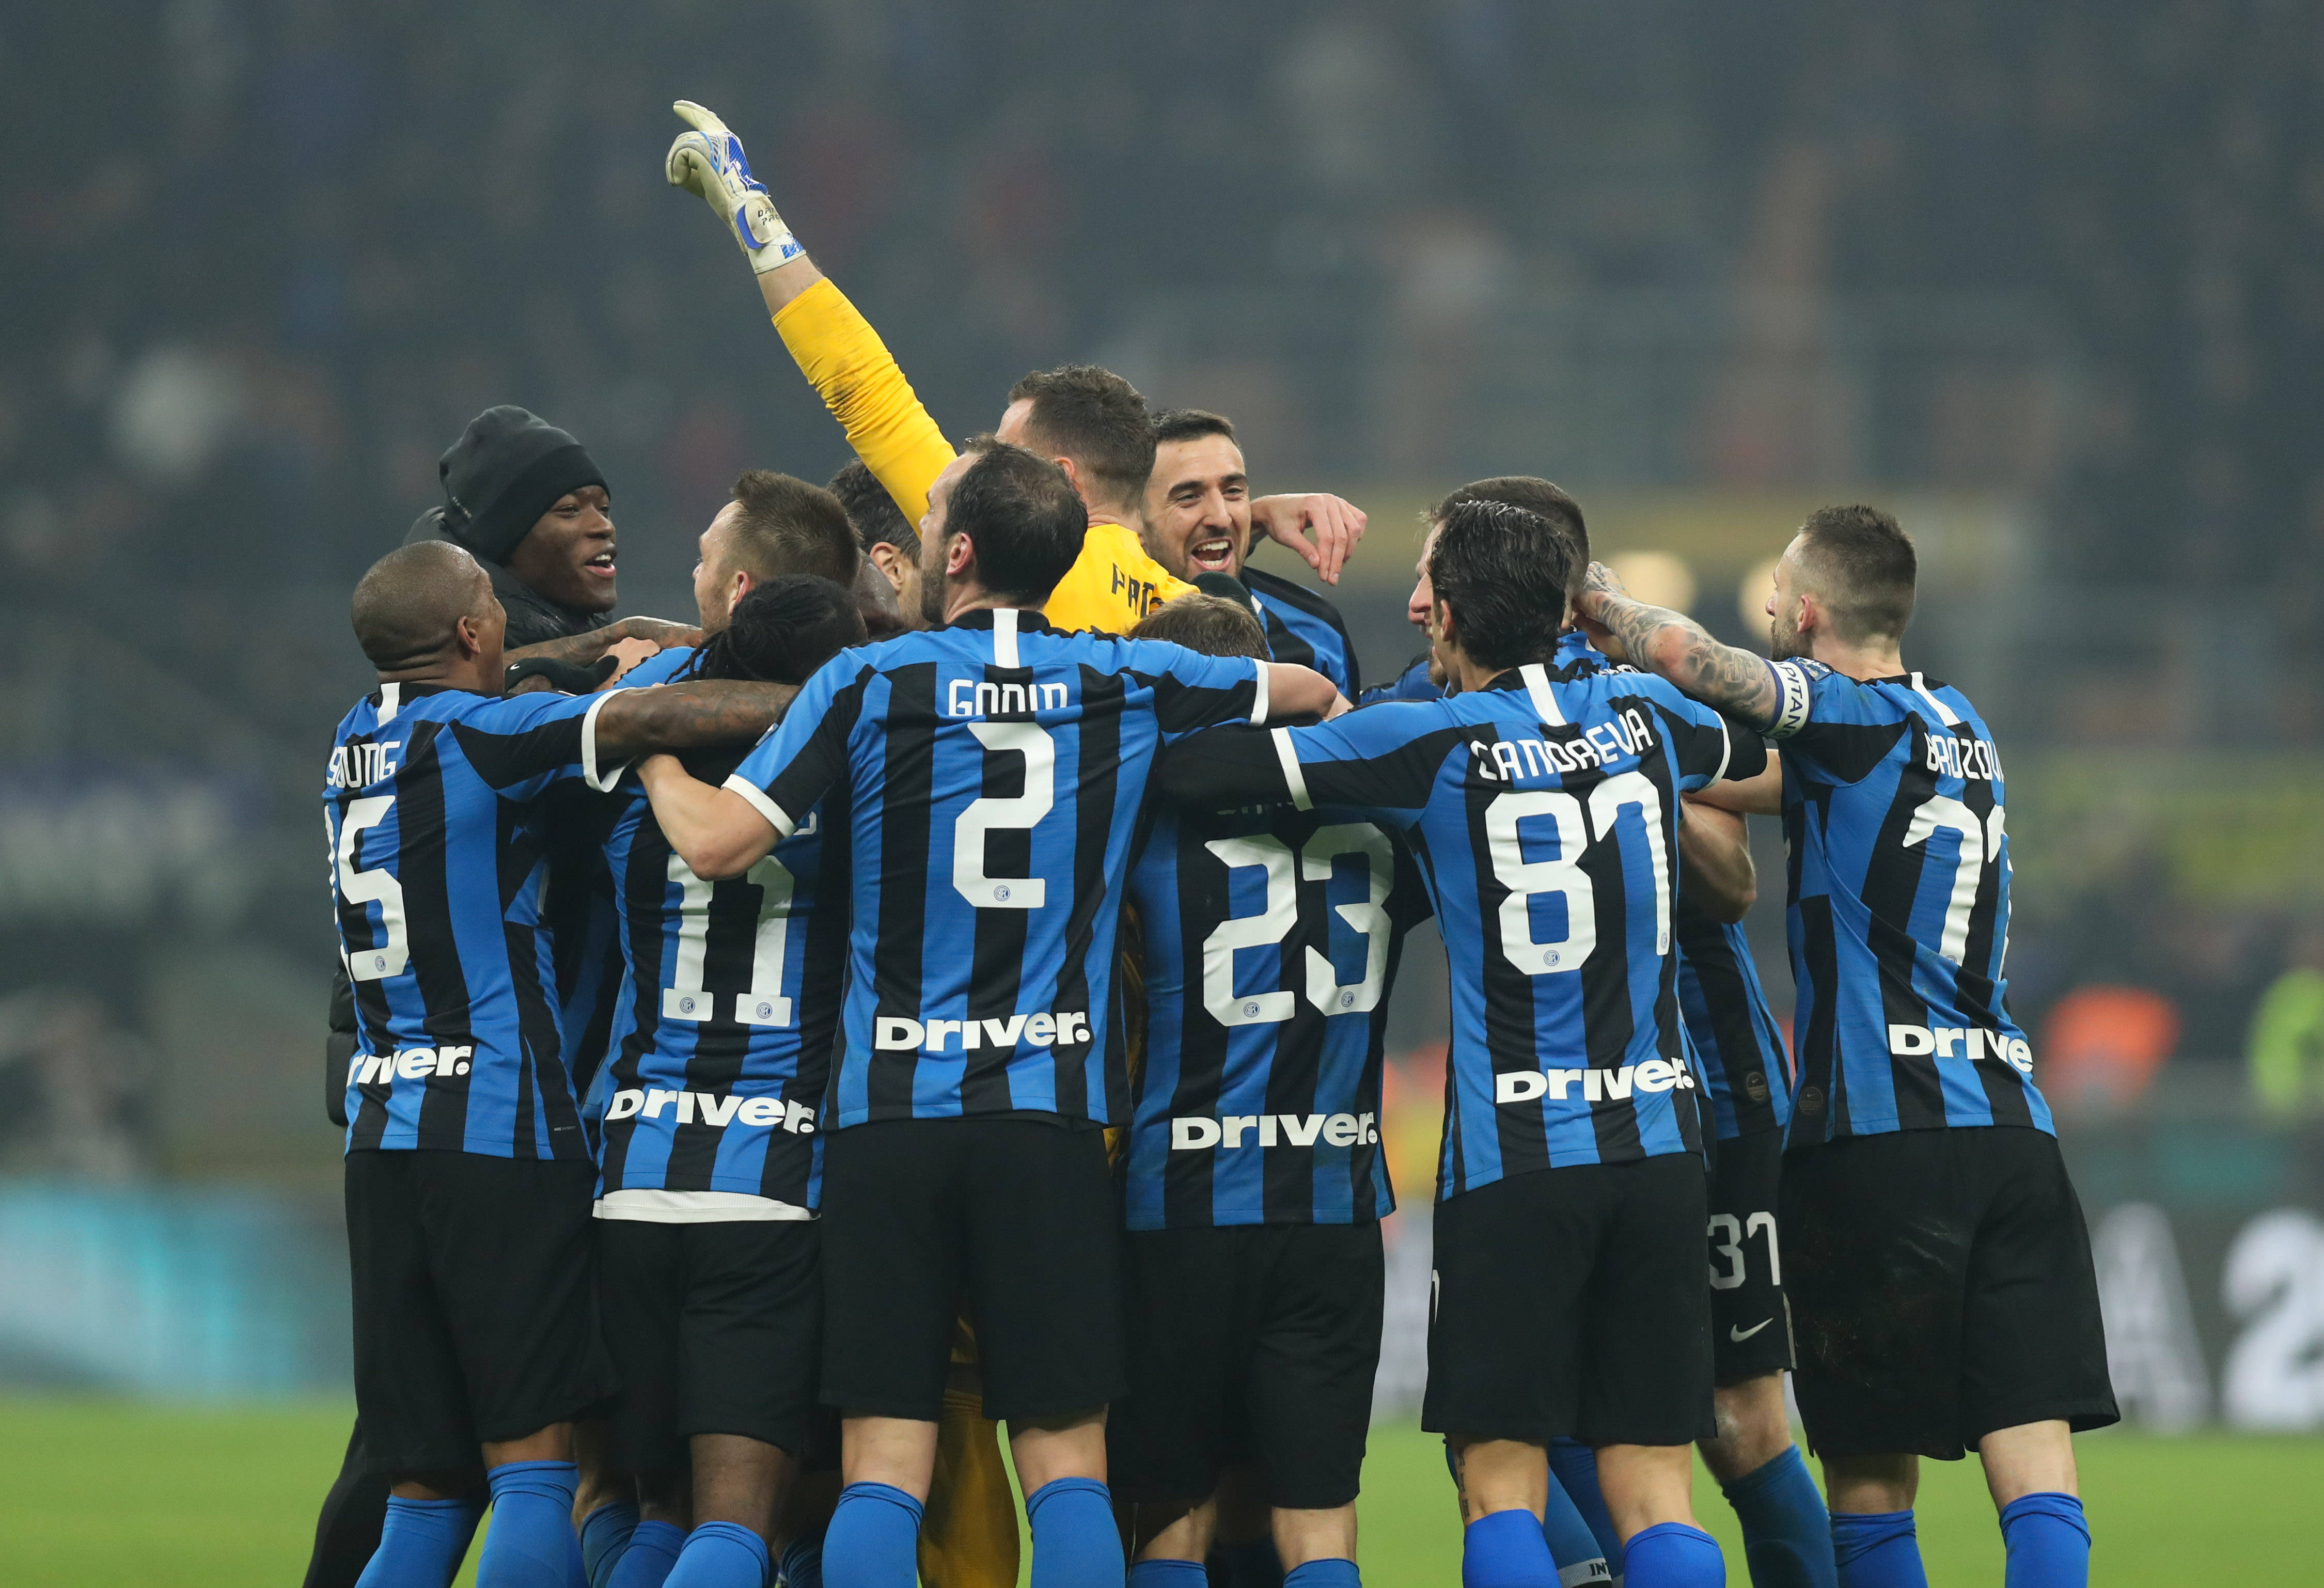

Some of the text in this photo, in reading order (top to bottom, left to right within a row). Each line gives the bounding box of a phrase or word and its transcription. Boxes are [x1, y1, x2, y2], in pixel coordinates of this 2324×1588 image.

[1470, 708, 1654, 781] CANDREVA
[1775, 663, 1802, 737] PITANO
[953, 722, 1055, 908] 2
[663, 854, 793, 1027] 11
[1203, 822, 1394, 1027] 23
